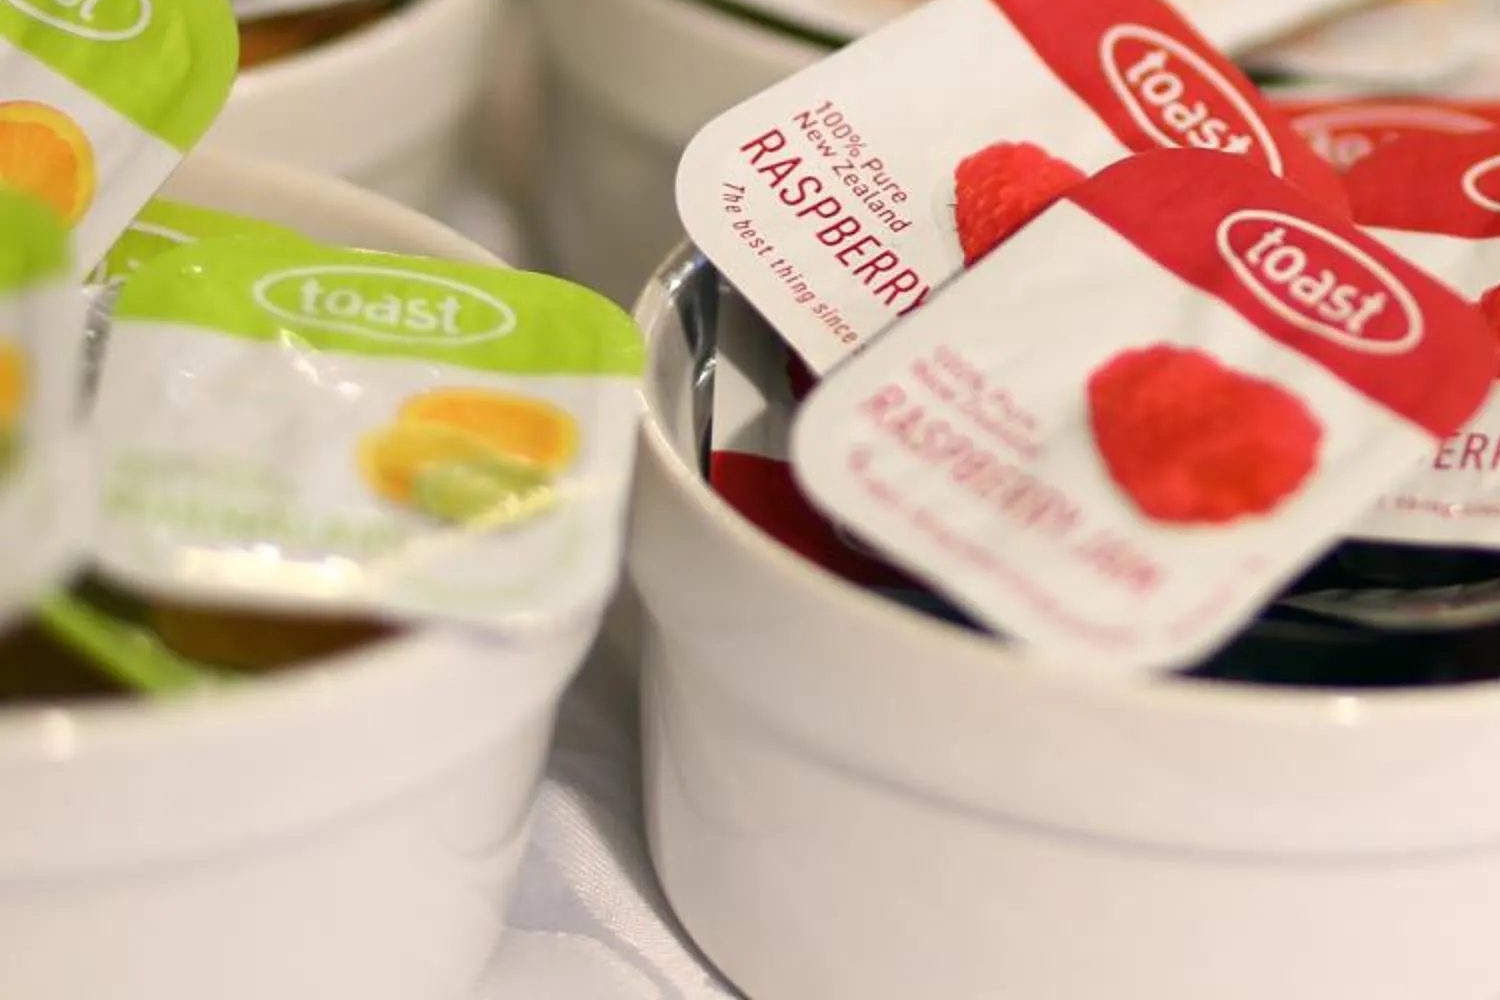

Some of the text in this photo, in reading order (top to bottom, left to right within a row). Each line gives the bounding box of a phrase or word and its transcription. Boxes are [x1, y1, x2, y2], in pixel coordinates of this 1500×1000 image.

[793, 110, 912, 233] New Zealand
[815, 100, 908, 204] 100% Pure
[722, 182, 859, 344] The best thing since
[739, 128, 931, 318] RASPBERRY
[1245, 227, 1387, 334] toast
[301, 277, 462, 335] toast
